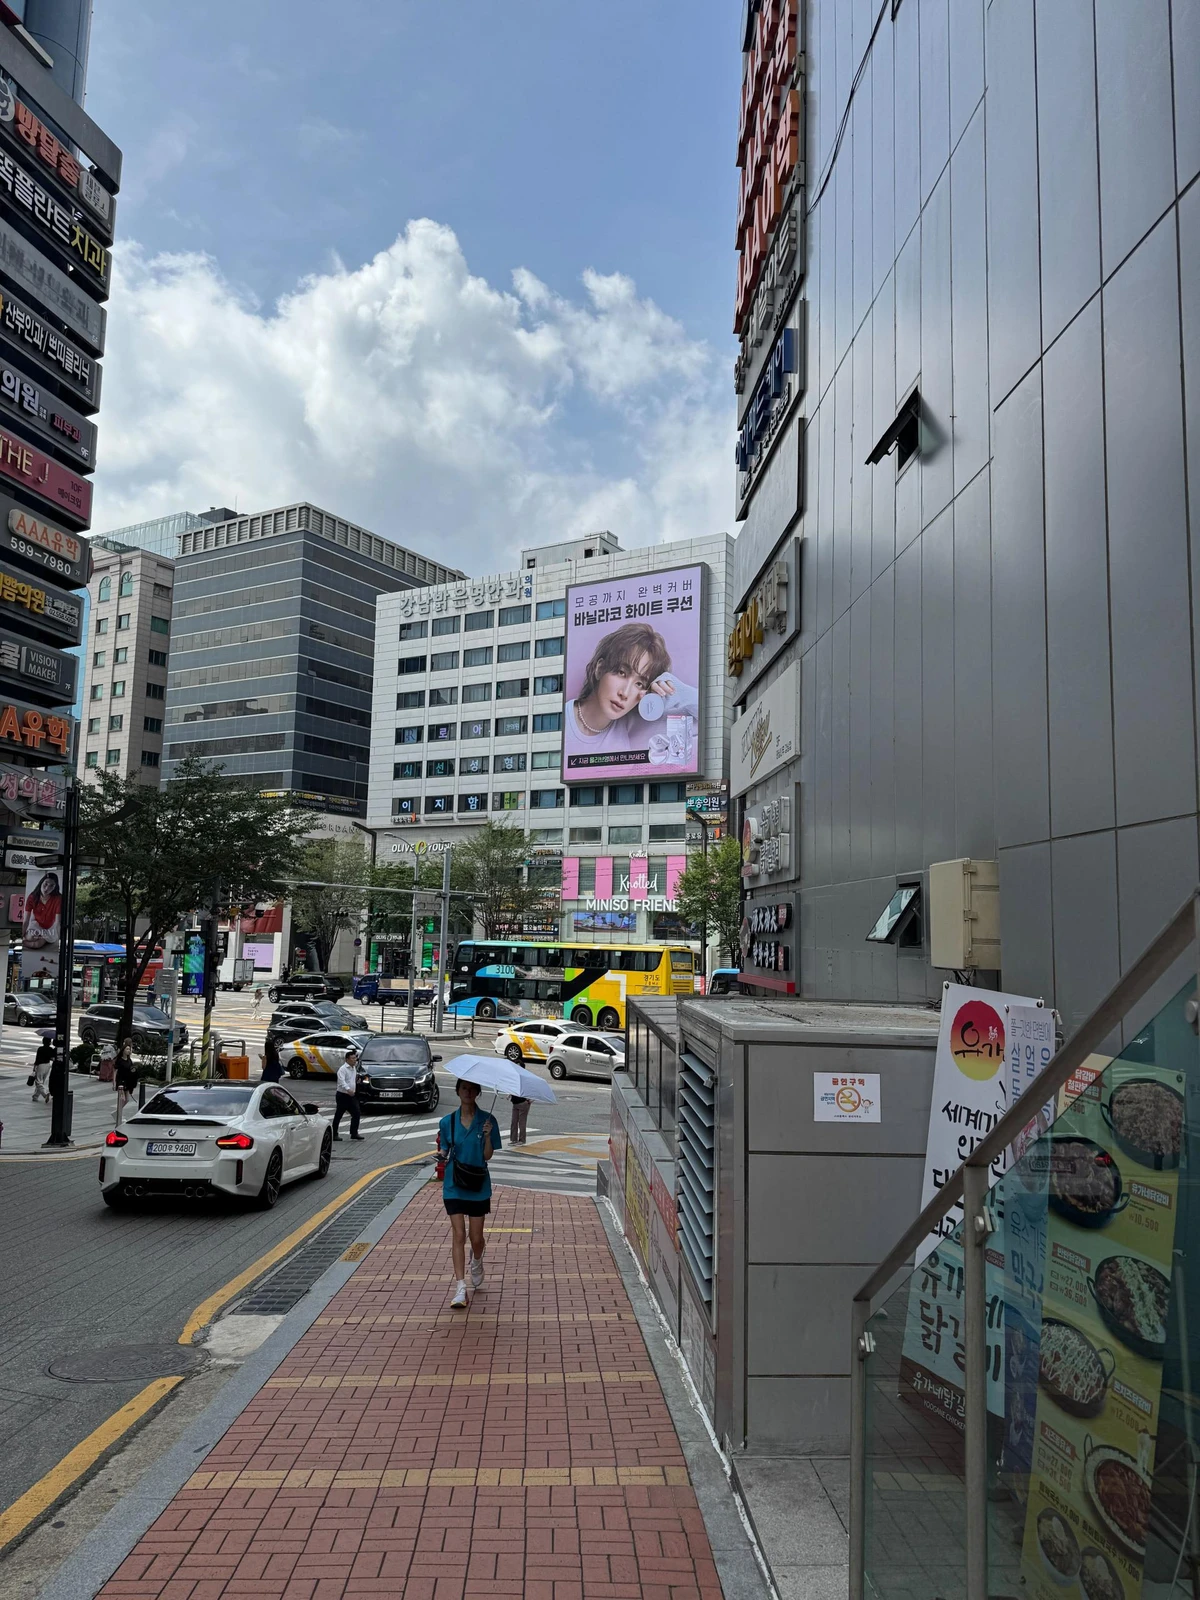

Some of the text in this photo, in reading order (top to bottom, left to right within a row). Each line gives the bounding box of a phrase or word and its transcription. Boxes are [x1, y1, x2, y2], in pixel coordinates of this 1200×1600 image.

[16, 102, 80, 188] 방탈출
[0, 370, 40, 416] 의원
[53, 414, 81, 442] 피부과
[71, 481, 82, 493] 10F
[57, 488, 81, 509] 메이크업
[15, 514, 79, 560] AAA유학
[10, 537, 71, 575] 599-7980
[524, 574, 533, 598] 의원
[575, 590, 626, 608] 모공까지
[574, 595, 693, 626] 바닐라코 화이트 쿠션
[30, 650, 57, 670] VISION
[28, 663, 57, 682] MAKER
[56, 800, 66, 810] 7F
[687, 797, 720, 809] 뽀송의원
[392, 843, 414, 853] OLIVE
[620, 873, 658, 893] Knotted
[586, 899, 630, 912] MINISO
[28, 929, 56, 938] ROEM
[495, 964, 516, 974] 3100
[643, 973, 660, 982] 경기도
[832, 1078, 865, 1087] 금연구역
[1075, 1067, 1096, 1083] 닭갈비
[174, 1144, 194, 1153] 9480
